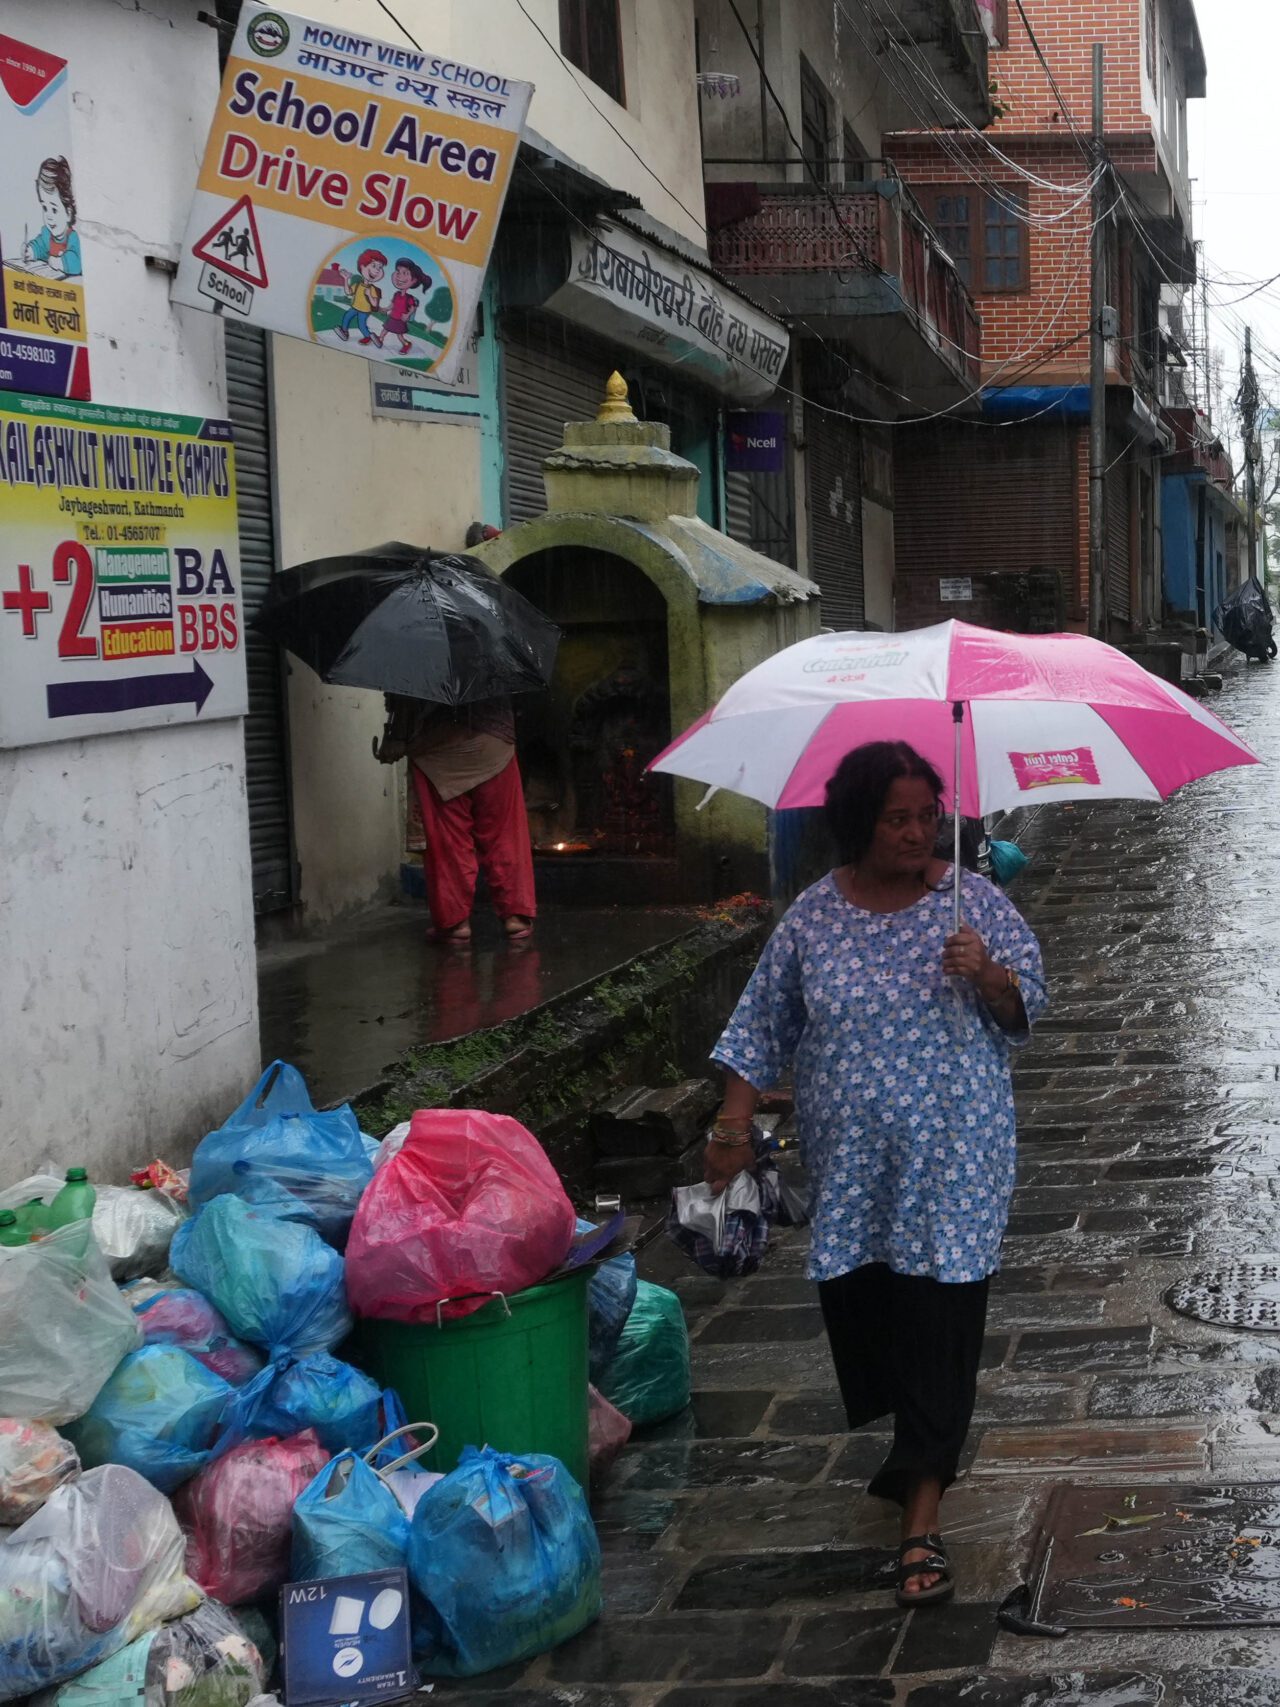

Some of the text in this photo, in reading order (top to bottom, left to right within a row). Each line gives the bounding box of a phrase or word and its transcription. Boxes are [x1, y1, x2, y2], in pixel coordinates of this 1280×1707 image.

[303, 26, 372, 57] MOUNT
[377, 45, 425, 71] VIEW
[429, 59, 510, 96] SCHOOL
[229, 72, 497, 181] School Area
[220, 134, 478, 241] Drive Slow
[208, 272, 247, 305] School
[0, 341, 56, 364] 01-4598103
[747, 437, 776, 449] Ncell
[102, 433, 174, 494] MULTIPLE
[175, 442, 229, 499] CAMPUS
[59, 496, 184, 518] Jaybageshwori, Kathmandu
[99, 550, 169, 578] Management
[174, 548, 235, 596] BA
[101, 588, 170, 617] Humanities
[104, 627, 173, 656] Education
[177, 603, 238, 652] BBS
[289, 1586, 327, 1604] 12W
[396, 1670, 407, 1687] 1
